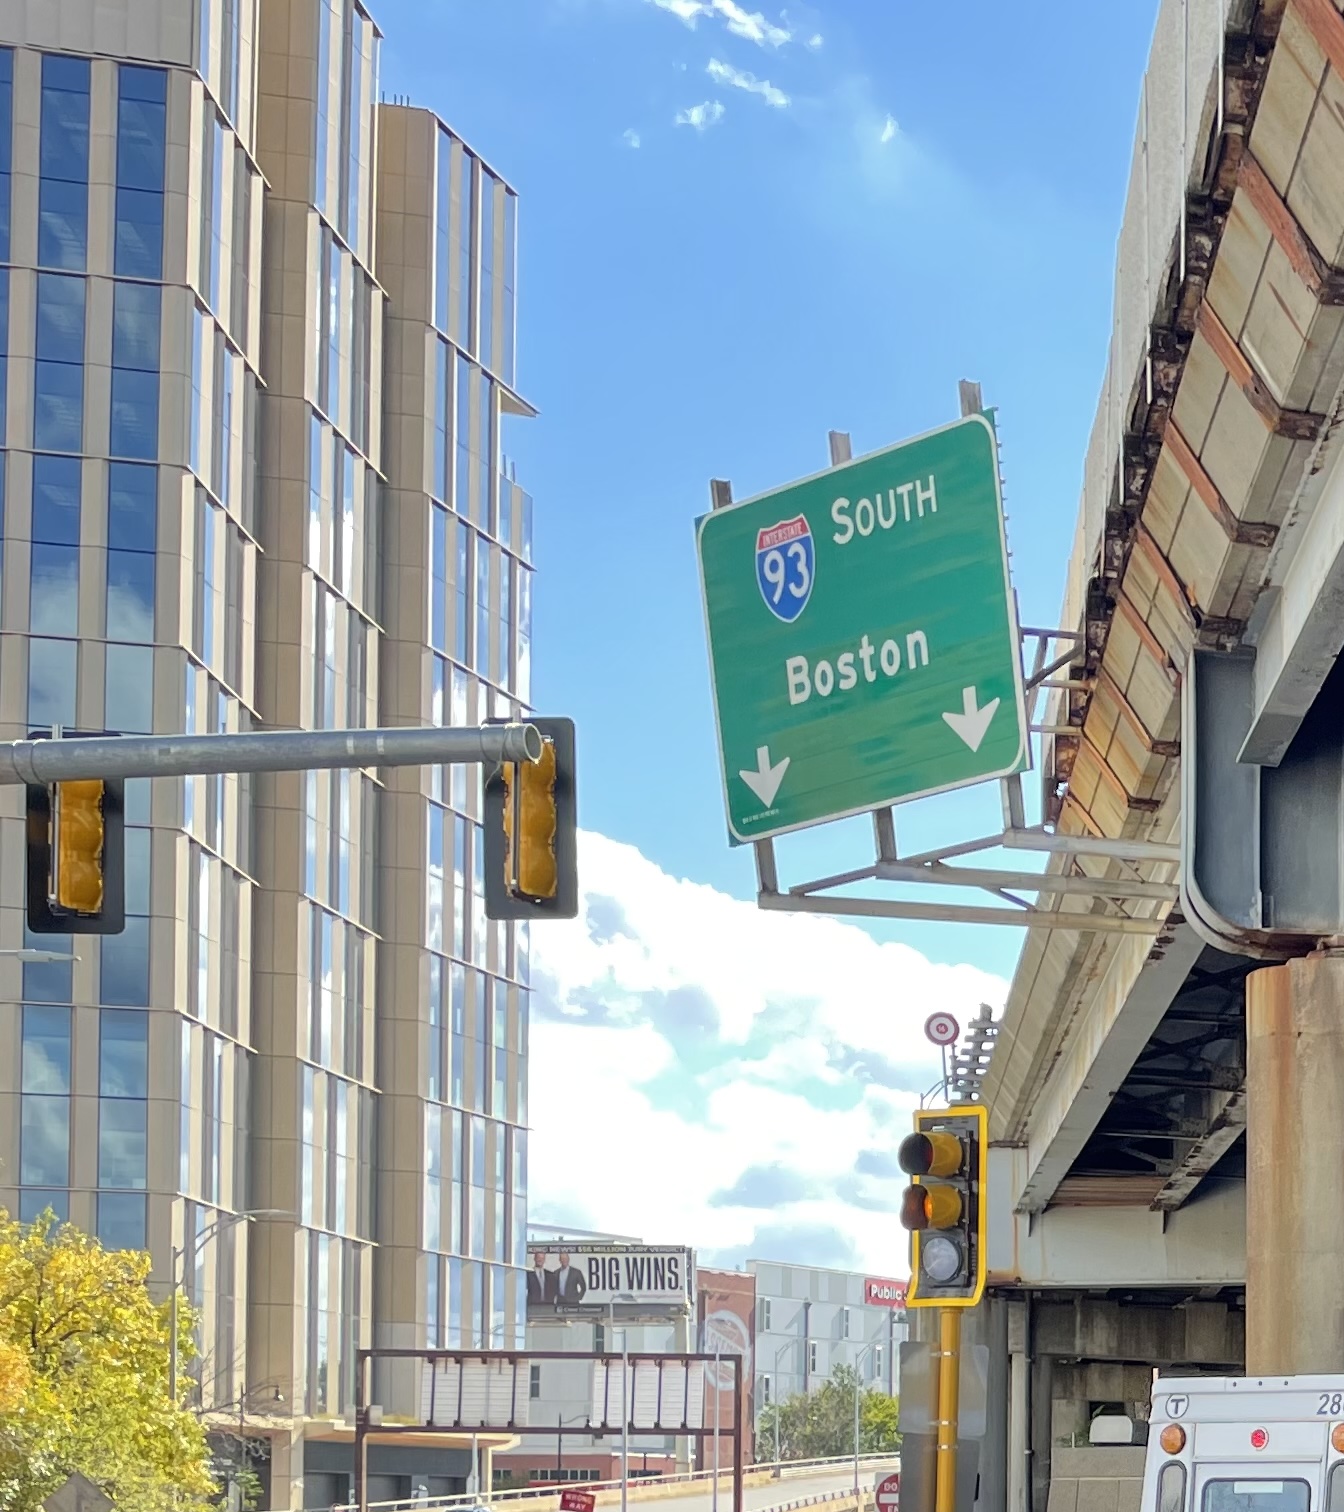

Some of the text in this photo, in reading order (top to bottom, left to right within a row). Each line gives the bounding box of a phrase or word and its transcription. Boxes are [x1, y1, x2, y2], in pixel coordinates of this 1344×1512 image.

[832, 474, 938, 545] SOUTH
[762, 521, 803, 548] INTERSTATE
[763, 542, 811, 605] 93
[785, 630, 930, 705] Boston
[588, 1256, 684, 1291] BIG WINS.
[870, 1283, 902, 1301] Public
[883, 1482, 898, 1492] DO
